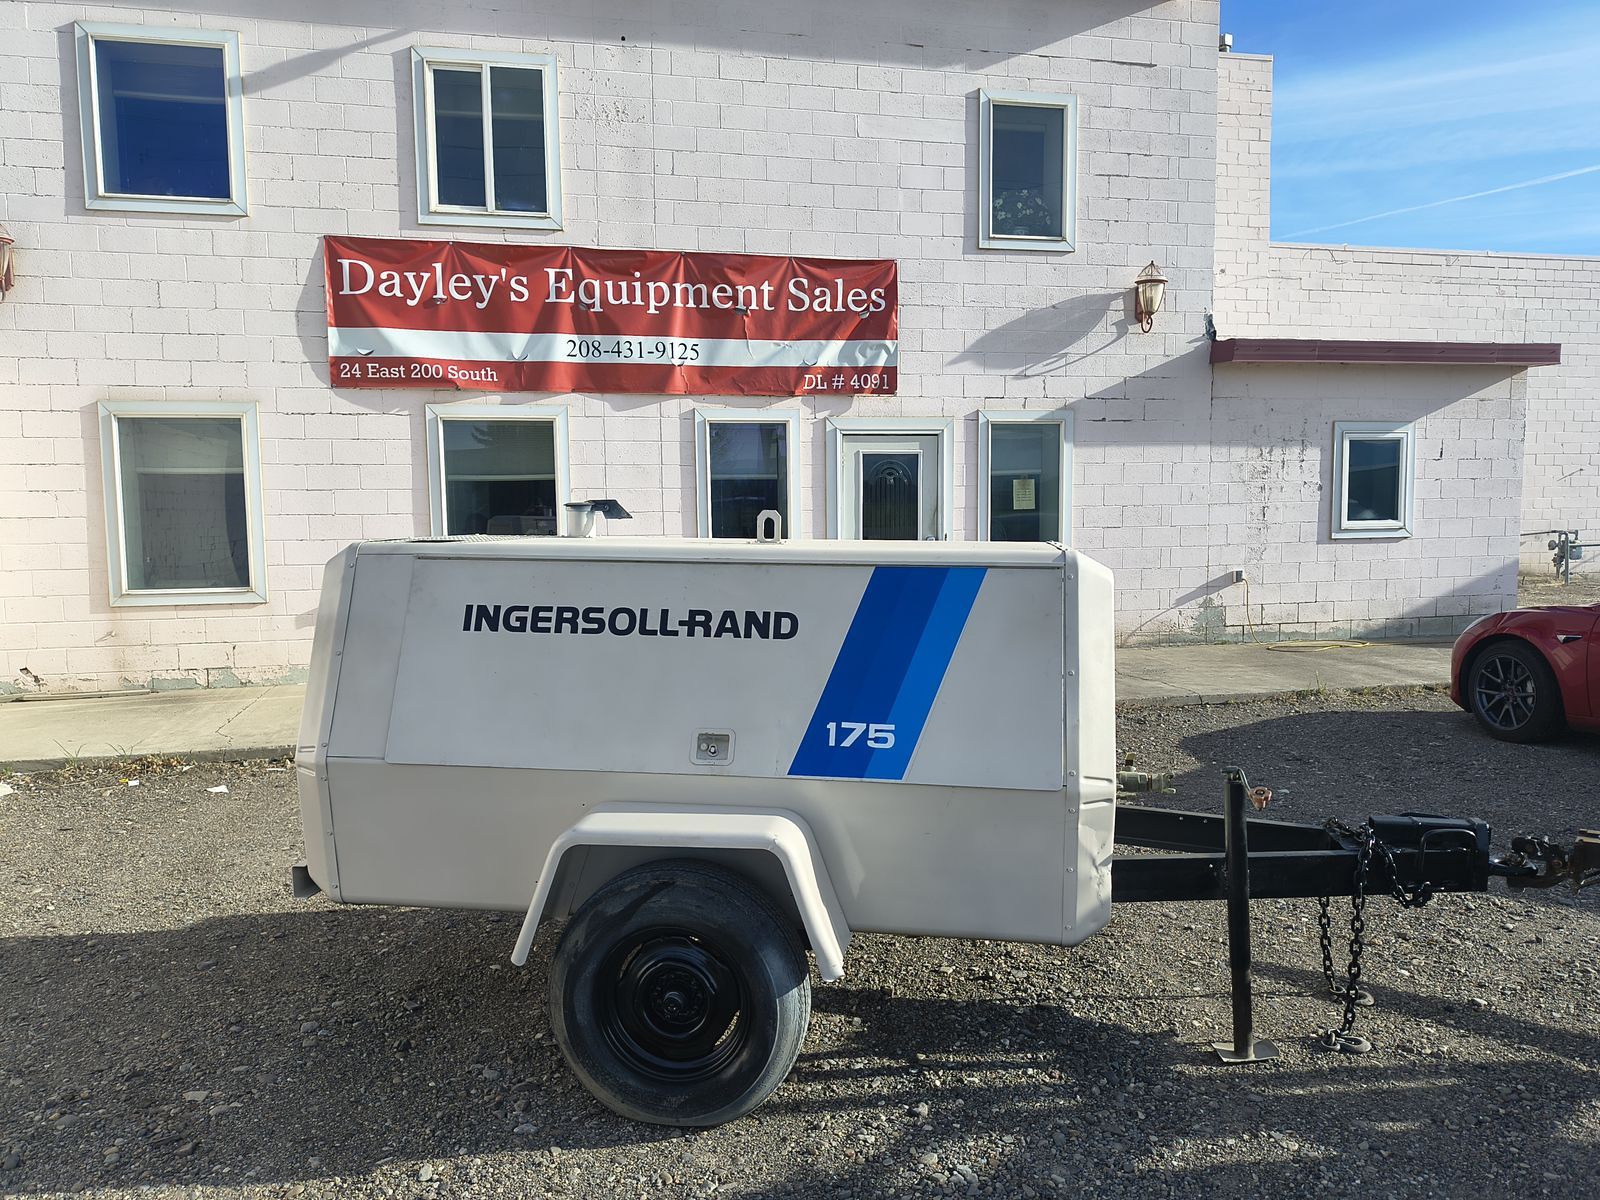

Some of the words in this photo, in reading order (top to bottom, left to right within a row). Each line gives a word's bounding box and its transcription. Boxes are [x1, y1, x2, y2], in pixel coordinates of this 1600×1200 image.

[337, 258, 529, 308] Dayley's
[545, 267, 775, 314] Equipment
[787, 277, 887, 314] Sales
[566, 339, 700, 362] 208-431-9125
[340, 364, 362, 379] 24
[367, 364, 407, 379] East
[411, 365, 443, 380] 200
[447, 366, 499, 382] South
[803, 374, 827, 389] DL
[832, 374, 847, 389] #
[850, 373, 890, 389] 4091
[463, 604, 799, 640] INGERSOLL-RAND
[826, 722, 896, 749] 175
